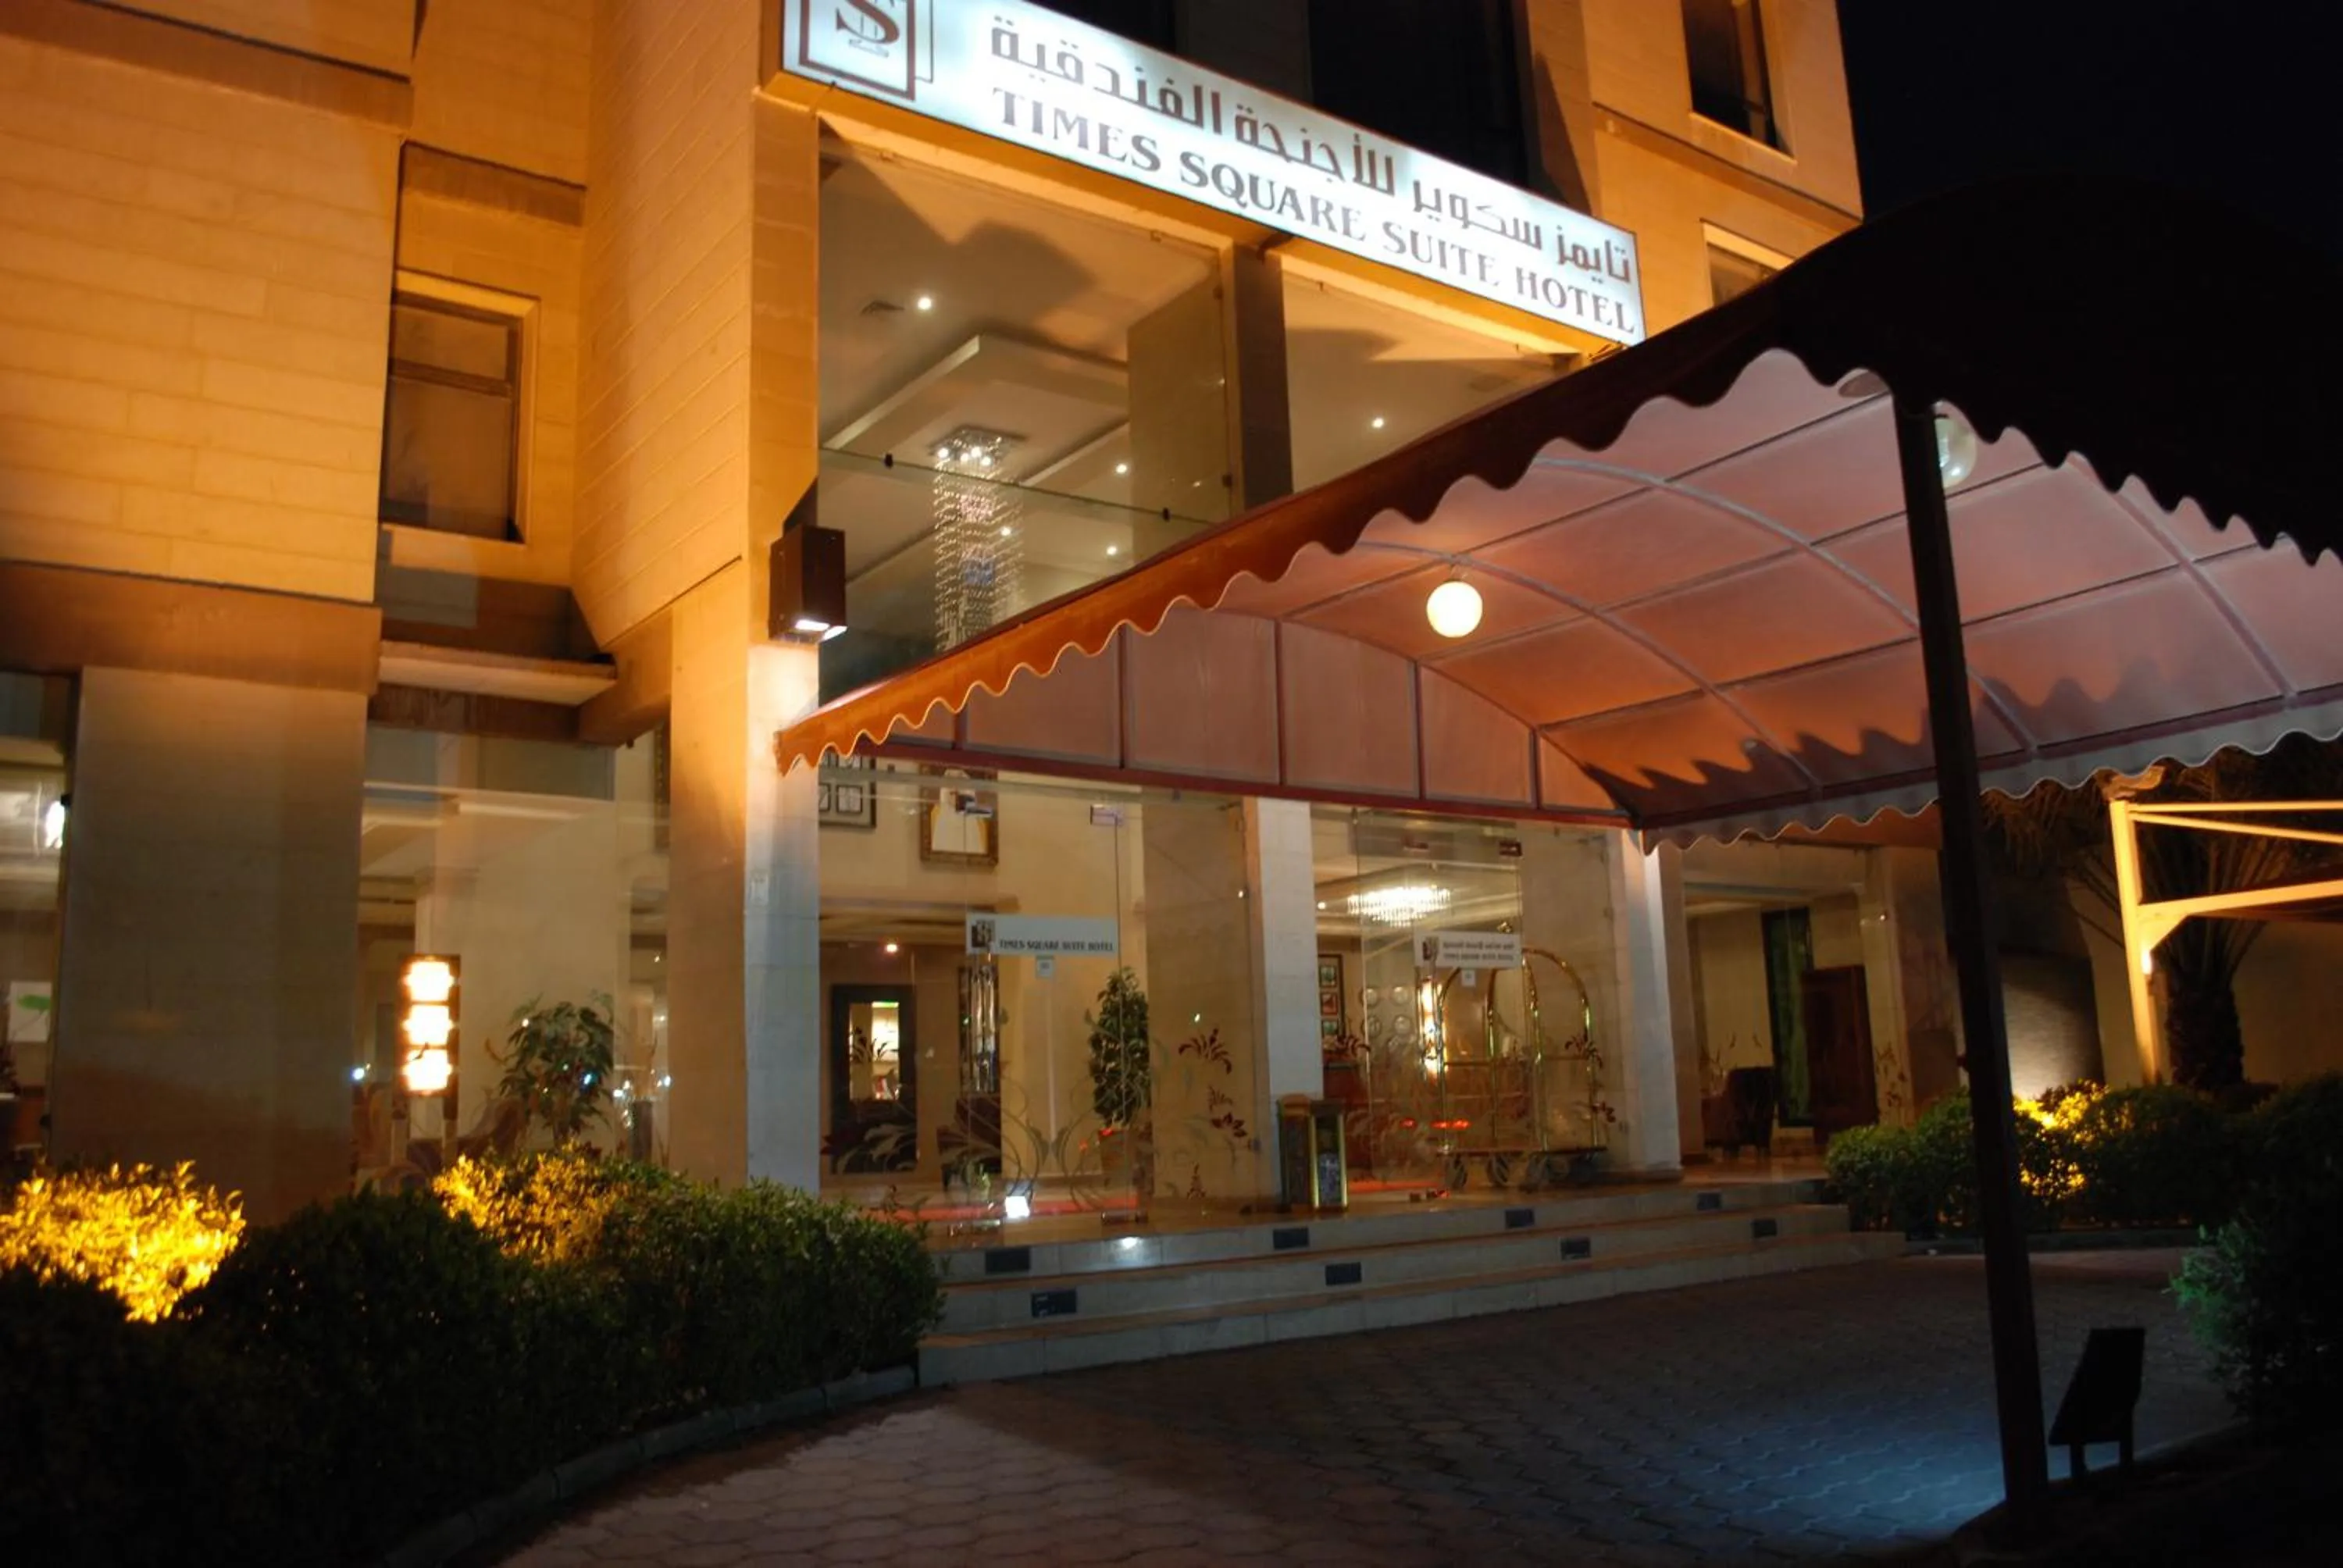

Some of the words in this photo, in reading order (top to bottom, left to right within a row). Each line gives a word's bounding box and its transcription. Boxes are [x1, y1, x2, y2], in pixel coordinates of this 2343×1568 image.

[991, 16, 1222, 134] الفندقية
[1236, 105, 1395, 195] للأجنحة
[993, 87, 1161, 172] TIMES
[1180, 151, 1366, 242] SQUARE
[1382, 221, 1500, 287] SUITE
[1515, 266, 1635, 334] HOTEL
[1414, 181, 1542, 250] سكوير
[1557, 225, 1631, 284] تايمز
[1000, 939, 1025, 950] TIMES
[1027, 939, 1059, 950] SQUARE
